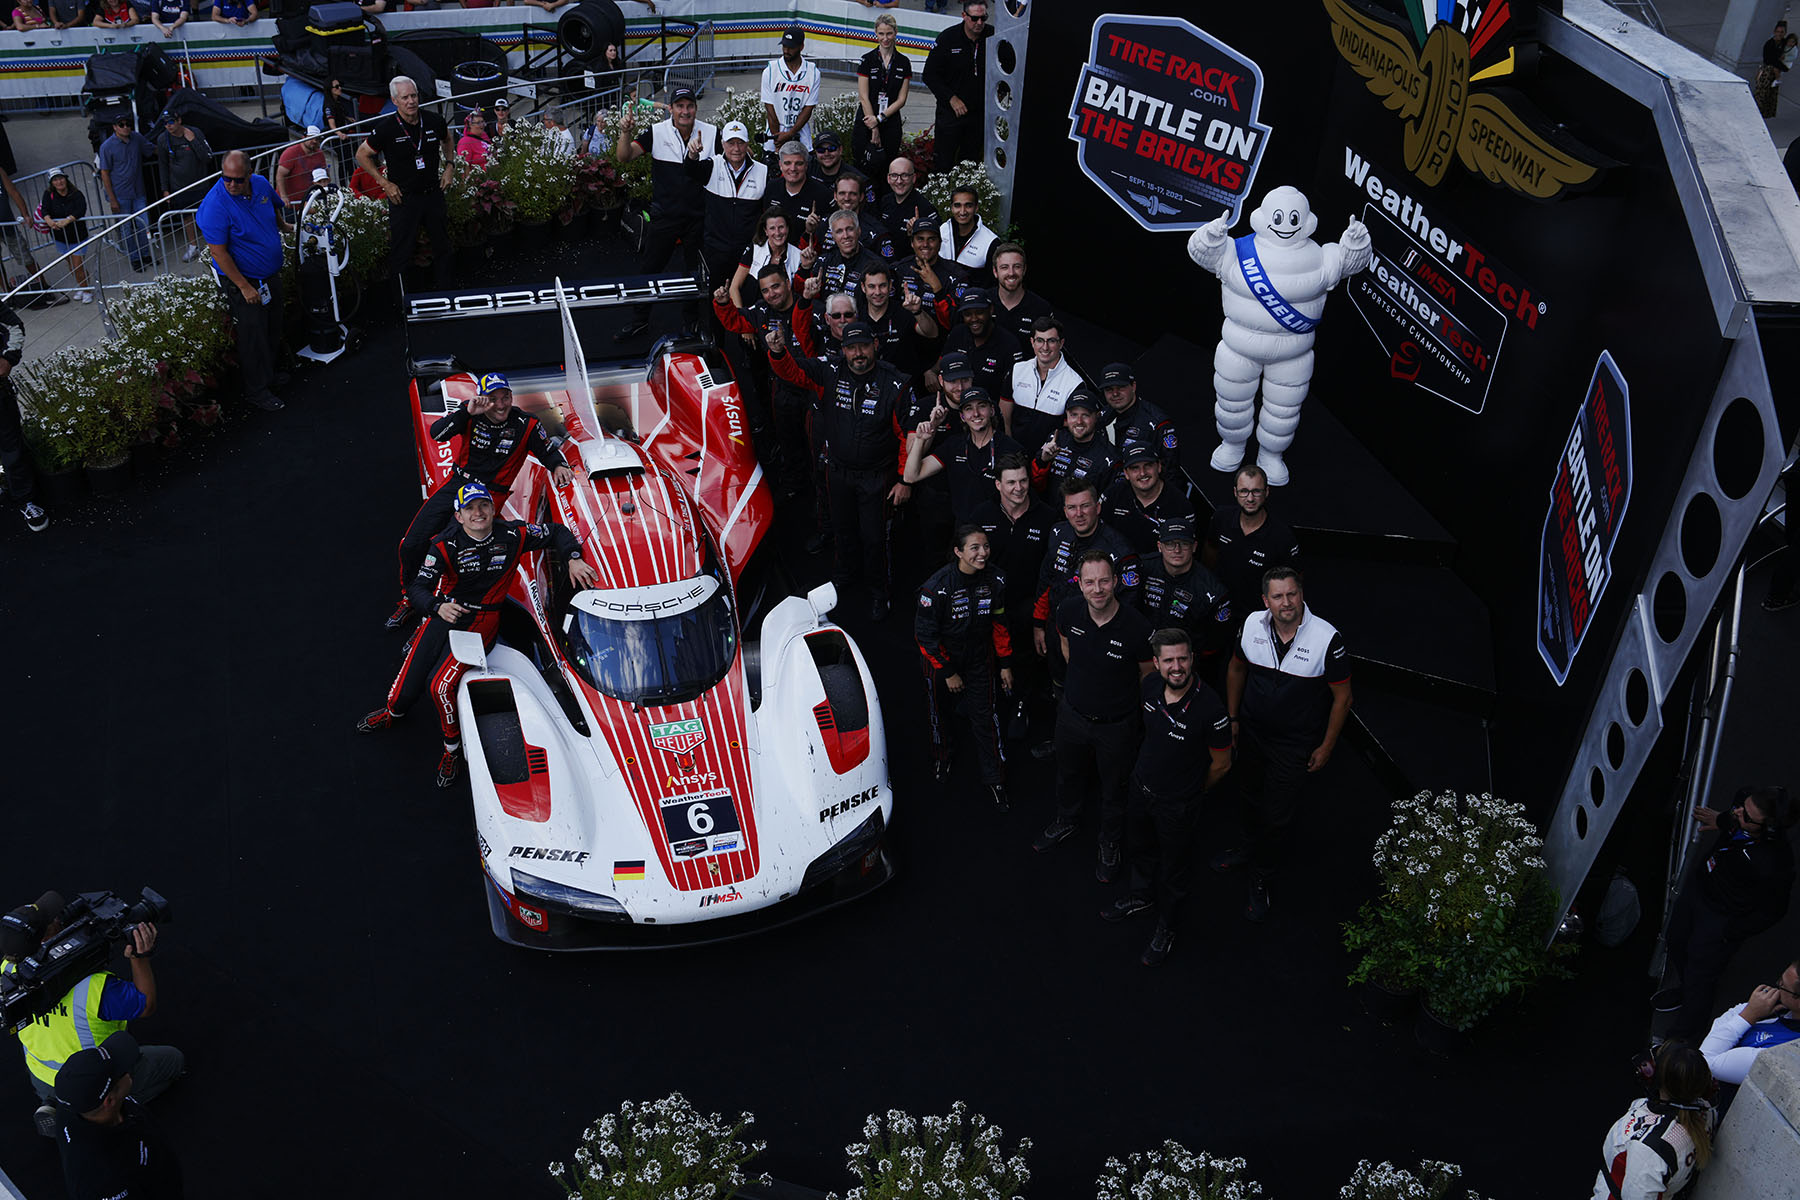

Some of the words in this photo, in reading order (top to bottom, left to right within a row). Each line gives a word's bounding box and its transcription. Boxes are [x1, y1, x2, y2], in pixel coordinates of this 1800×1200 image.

[1339, 24, 1421, 99] INDIANAPOLIS
[783, 97, 801, 111] 243
[1084, 75, 1203, 143] BATTLE
[1204, 118, 1258, 162] ON
[1190, 86, 1228, 108] .com
[1427, 51, 1465, 176] MOTOR
[1080, 106, 1135, 151] THE
[1135, 129, 1246, 192] BRICKS
[1468, 118, 1546, 189] SPEEDWAY
[1128, 175, 1147, 188] SEPT.
[1165, 188, 1184, 201] 2023
[1344, 145, 1541, 332] WeatherTech
[410, 276, 700, 316] PORSCHE
[1242, 257, 1314, 331] MICHELIN
[1416, 263, 1457, 307] IMSA
[1409, 325, 1472, 385] CHAMPIONSHIP
[720, 395, 745, 447] Ansys
[436, 440, 454, 479] nsys
[1554, 460, 1573, 534] THE
[1567, 423, 1597, 553] BATTLE
[1584, 534, 1606, 606] ON
[592, 584, 705, 613] PORSCHE
[1562, 525, 1589, 639] BRICKS
[437, 661, 463, 725] PORSCH
[654, 721, 699, 737] TAG
[655, 731, 703, 752] HEUER
[662, 789, 729, 805] WeatherTech
[665, 771, 718, 789] Ansys
[686, 802, 715, 835] 6
[819, 784, 879, 824] PENSKE
[508, 845, 590, 863] PENSKE
